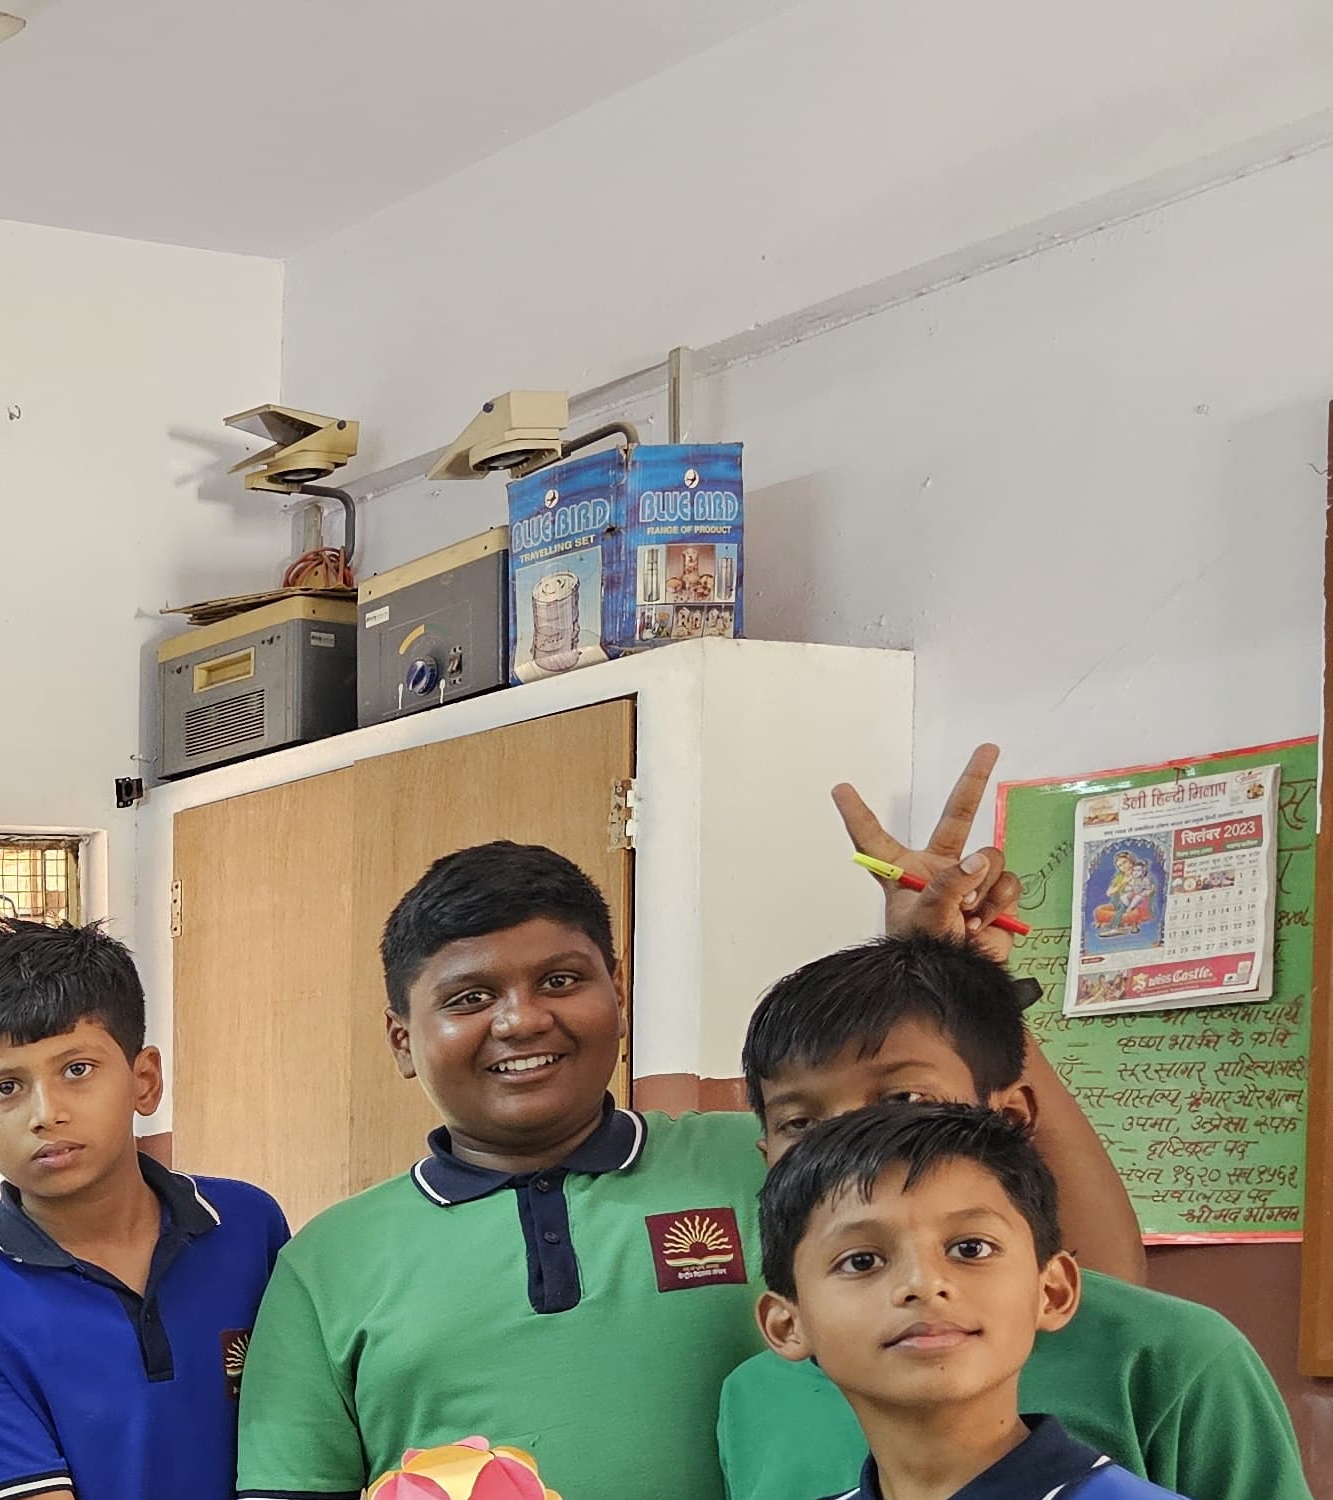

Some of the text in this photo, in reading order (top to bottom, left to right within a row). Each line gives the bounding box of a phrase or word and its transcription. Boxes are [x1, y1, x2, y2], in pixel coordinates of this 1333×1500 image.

[639, 490, 738, 523] BLUE BIRD
[511, 498, 611, 553] BLUE BIRD
[647, 525, 732, 536] RANGE OF PRODUCT
[519, 534, 596, 564] TRAVELLING SET
[1122, 790, 1147, 811] डेली
[1151, 784, 1185, 808] हिन्दी
[1188, 781, 1227, 802] मिलाप
[1180, 826, 1221, 847] सितंबर
[1224, 821, 1256, 838] 2023
